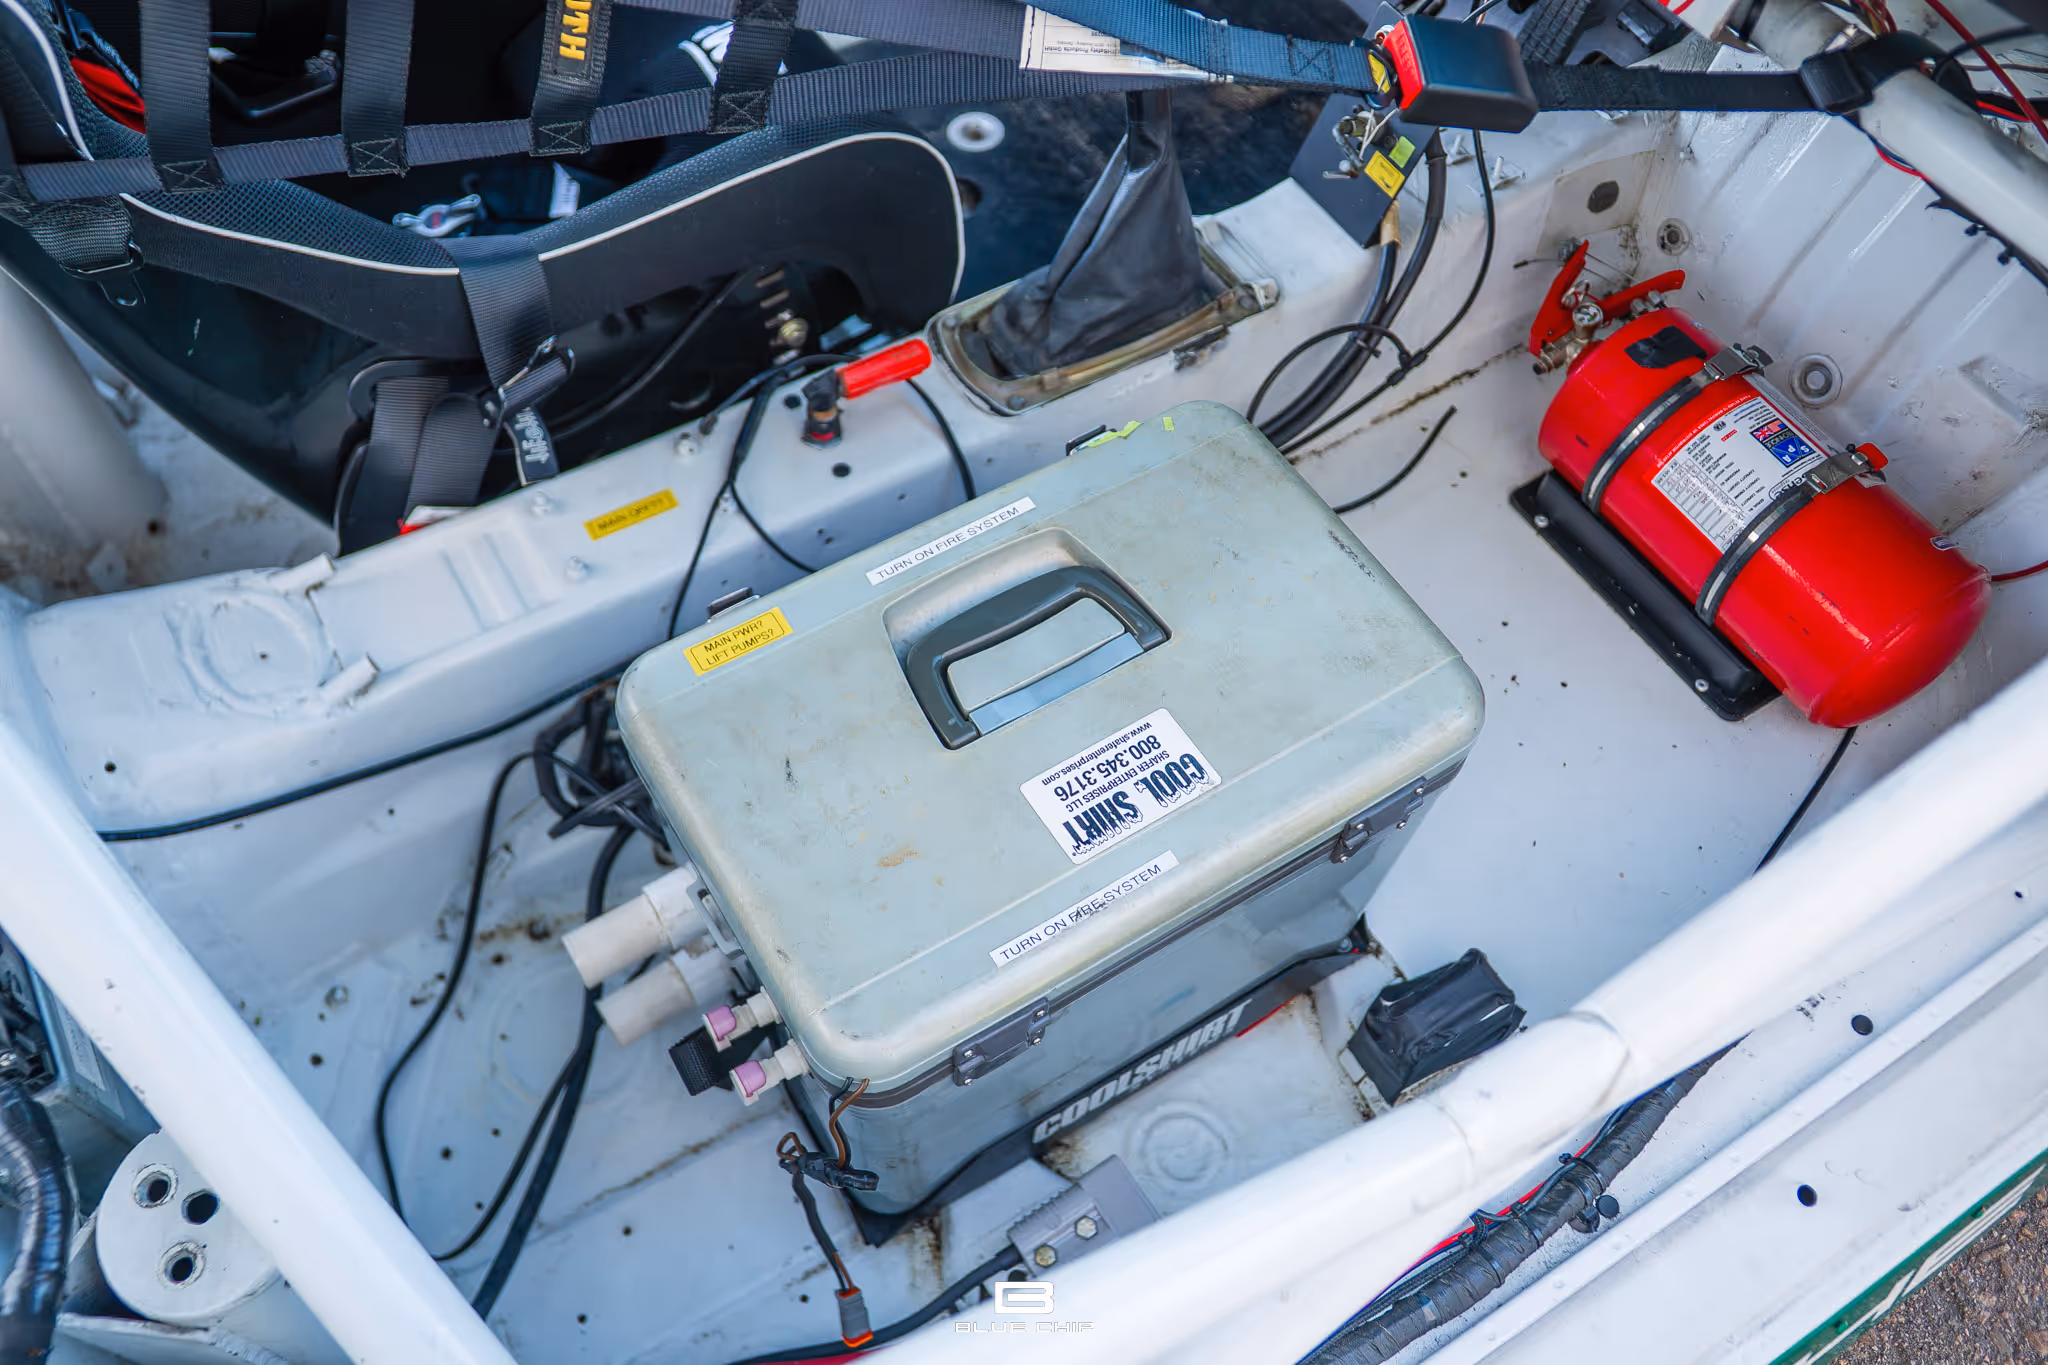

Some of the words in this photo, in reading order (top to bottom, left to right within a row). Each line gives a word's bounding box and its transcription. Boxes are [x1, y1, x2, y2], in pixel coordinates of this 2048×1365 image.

[1739, 468, 1755, 482] CAPACITY
[1744, 476, 1760, 490] CAPACITY
[1740, 492, 1756, 506] CAPACITY
[876, 556, 912, 580] TURN
[913, 546, 934, 562] ON
[935, 531, 965, 552] FIRE
[966, 505, 1019, 537] SYSTEM
[703, 634, 731, 652] MAIN
[731, 619, 763, 639] PWR?
[706, 648, 729, 665] LIFT
[730, 627, 775, 654] PUMPS?
[1041, 720, 1152, 787] www.shaferenterprises.com
[1052, 733, 1161, 803] 800.345.3176
[1136, 749, 1170, 773] SHAFER
[1081, 767, 1137, 803] ENTERPRISES
[1132, 751, 1211, 808] COOL
[1064, 798, 1083, 812] LLC
[999, 931, 1042, 961] TURN
[1042, 917, 1067, 937] ON
[1068, 898, 1102, 923] FIRE
[1102, 863, 1161, 903] SYSTEM
[1034, 997, 1251, 1144] COOLSHIRT
